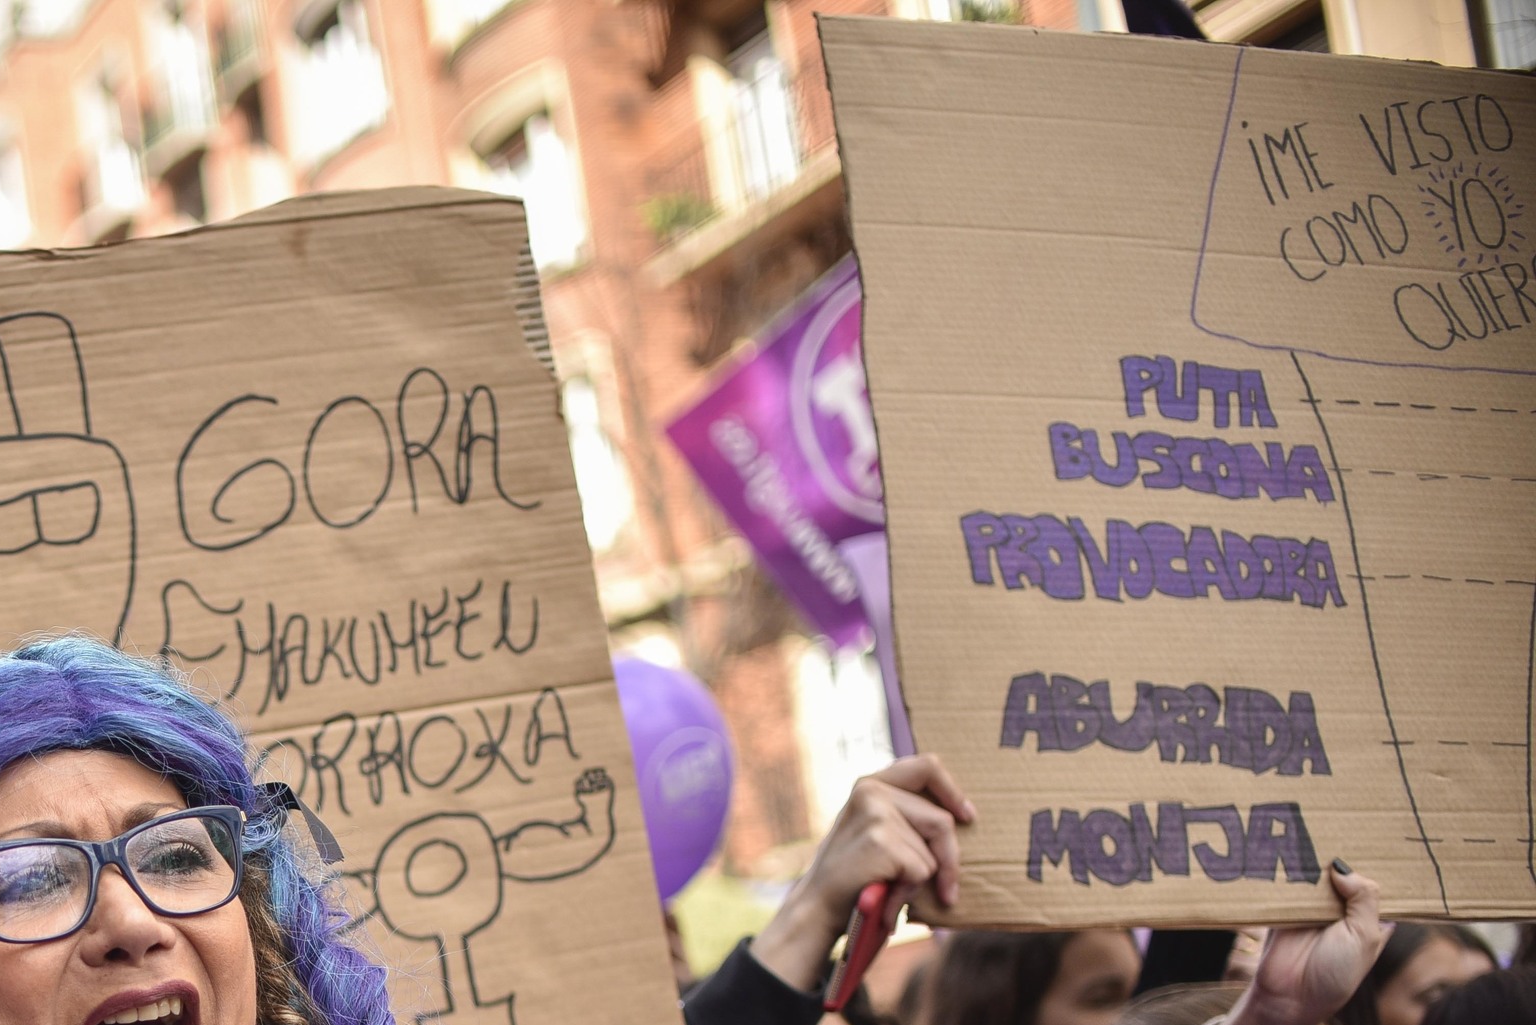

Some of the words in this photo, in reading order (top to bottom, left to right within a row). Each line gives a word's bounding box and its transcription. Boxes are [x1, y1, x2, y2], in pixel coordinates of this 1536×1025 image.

[1360, 94, 1513, 176] VISTO
[1280, 194, 1409, 282] COMO
[1427, 178, 1507, 252] YO
[1120, 354, 1279, 429] PUTA
[176, 367, 543, 551] GORA
[1048, 422, 1336, 504] BUSCONA
[960, 510, 1348, 610] PROVOCADORA
[999, 670, 1333, 777] ABURRIDA
[1026, 801, 1322, 887] MONJA
